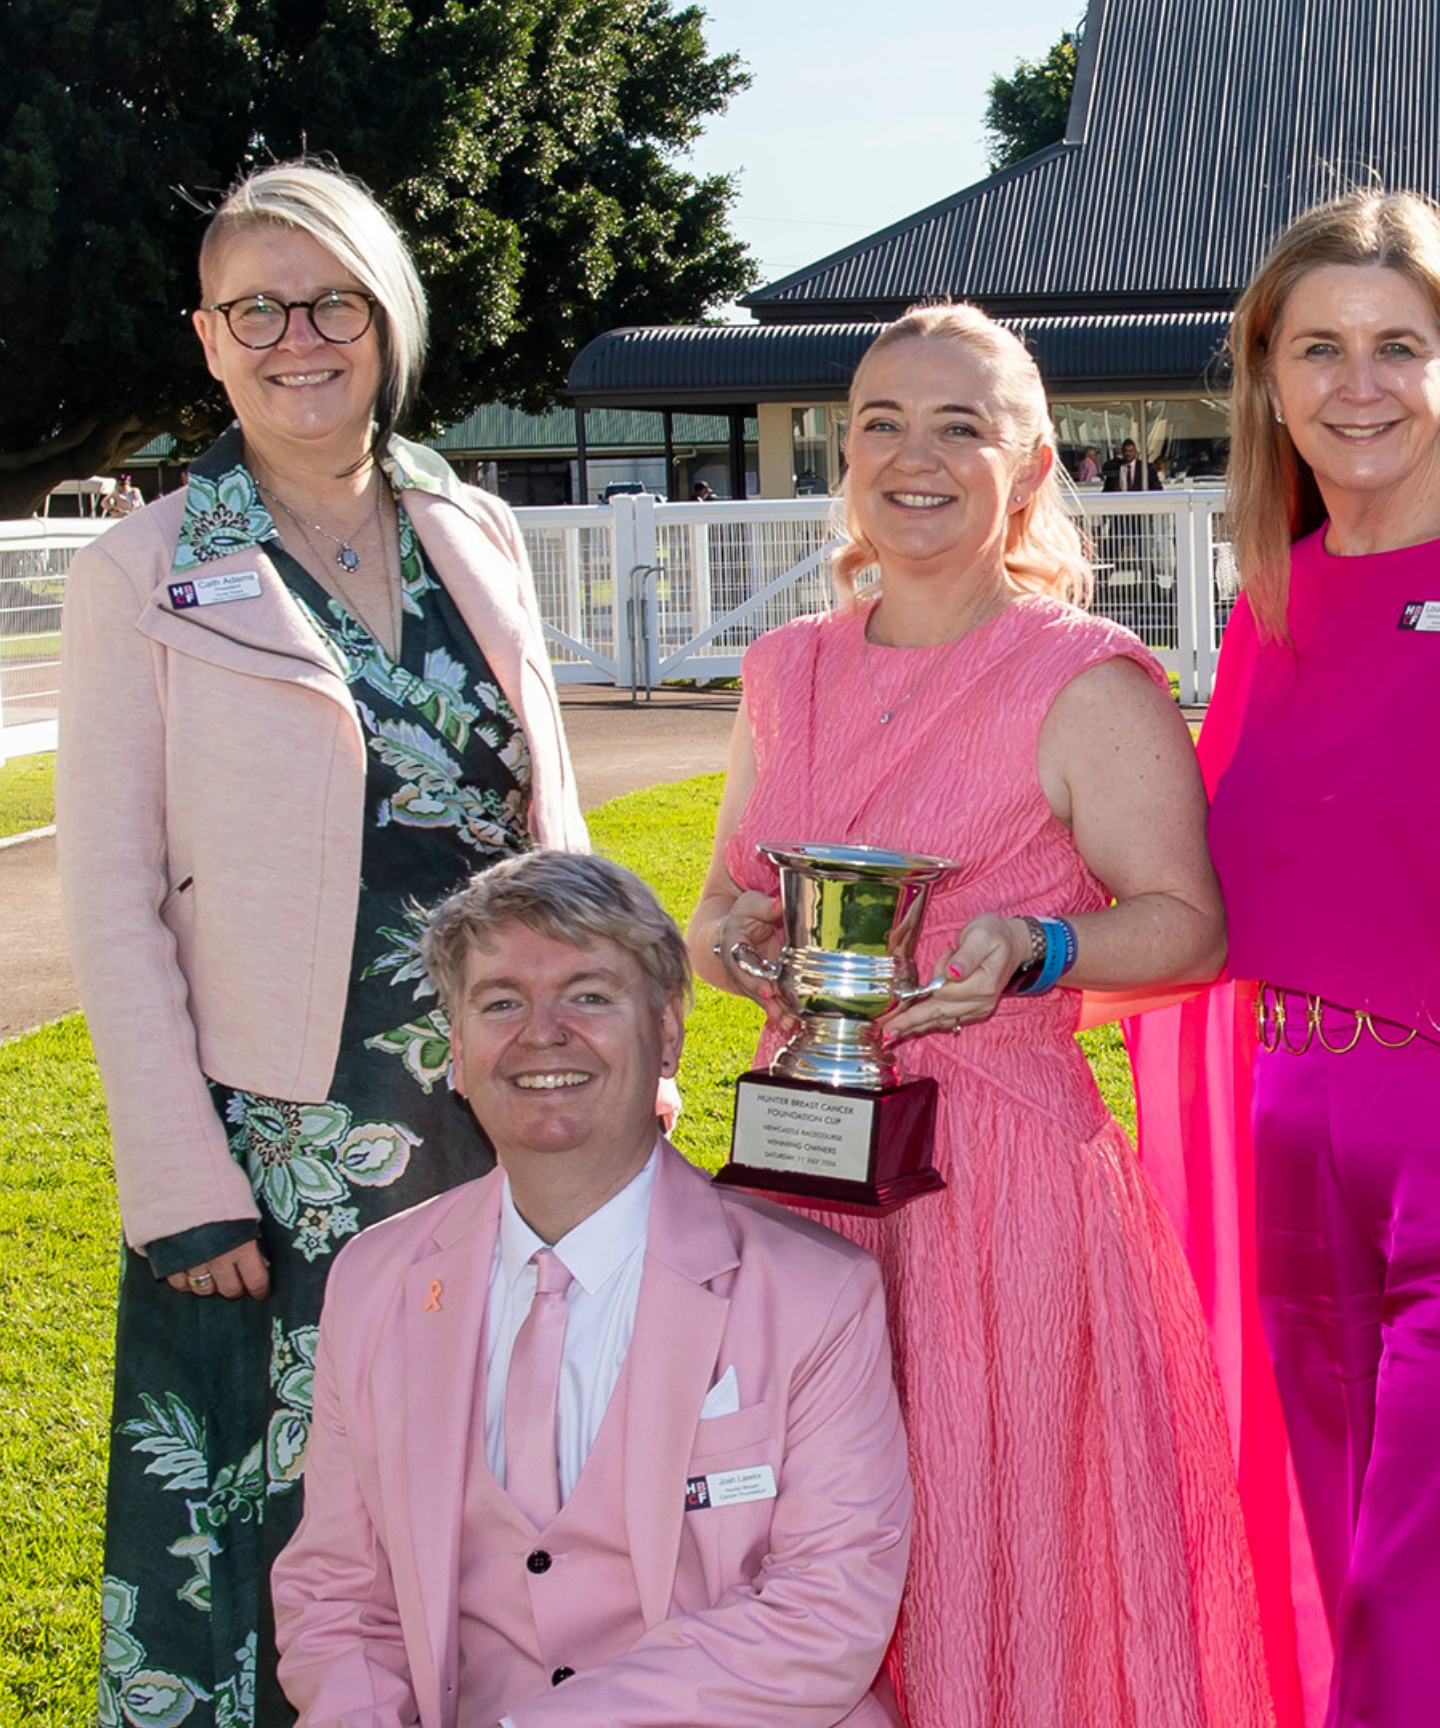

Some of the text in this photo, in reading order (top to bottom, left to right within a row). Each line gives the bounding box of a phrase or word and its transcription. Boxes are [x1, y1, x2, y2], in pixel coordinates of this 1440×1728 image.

[757, 1094, 854, 1115] HUNTER BREAST CANCER
[767, 1108, 842, 1126] FOUNDATION CUP
[804, 1142, 837, 1155] OWNERS
